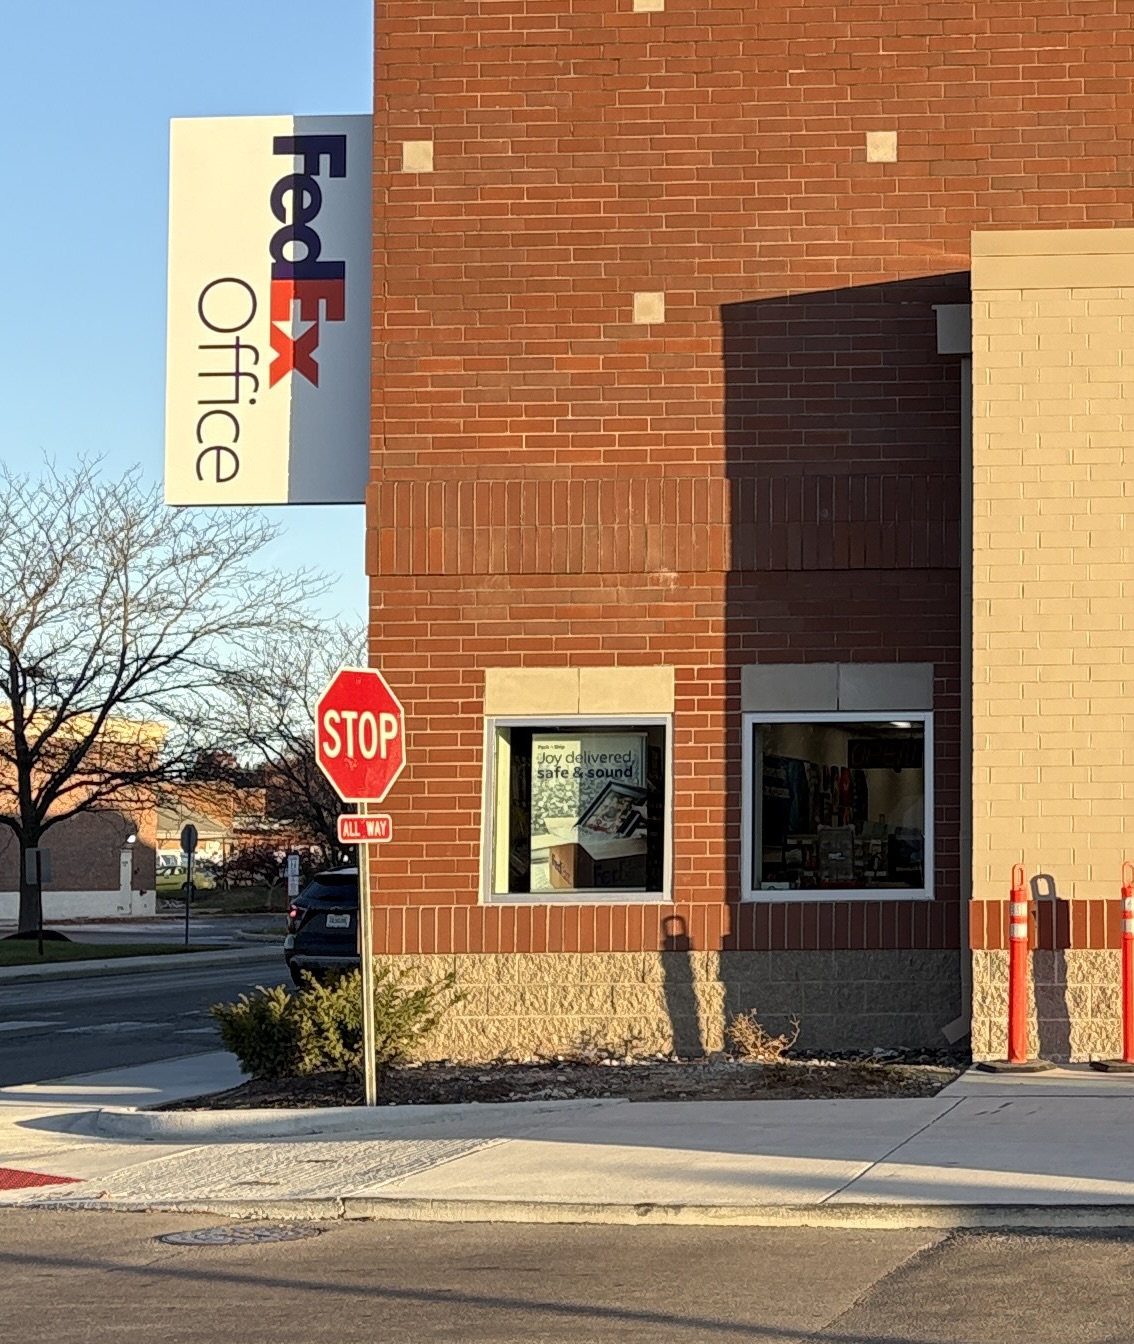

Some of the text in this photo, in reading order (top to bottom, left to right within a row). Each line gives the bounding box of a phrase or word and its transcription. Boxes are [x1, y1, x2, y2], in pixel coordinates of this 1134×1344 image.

[269, 134, 347, 389] FedEx
[196, 277, 260, 483] Office
[322, 709, 399, 760] STOP
[537, 765, 633, 779] safe & sound
[538, 750, 635, 766] Joy delivered,
[342, 821, 388, 837] ALL WAY
